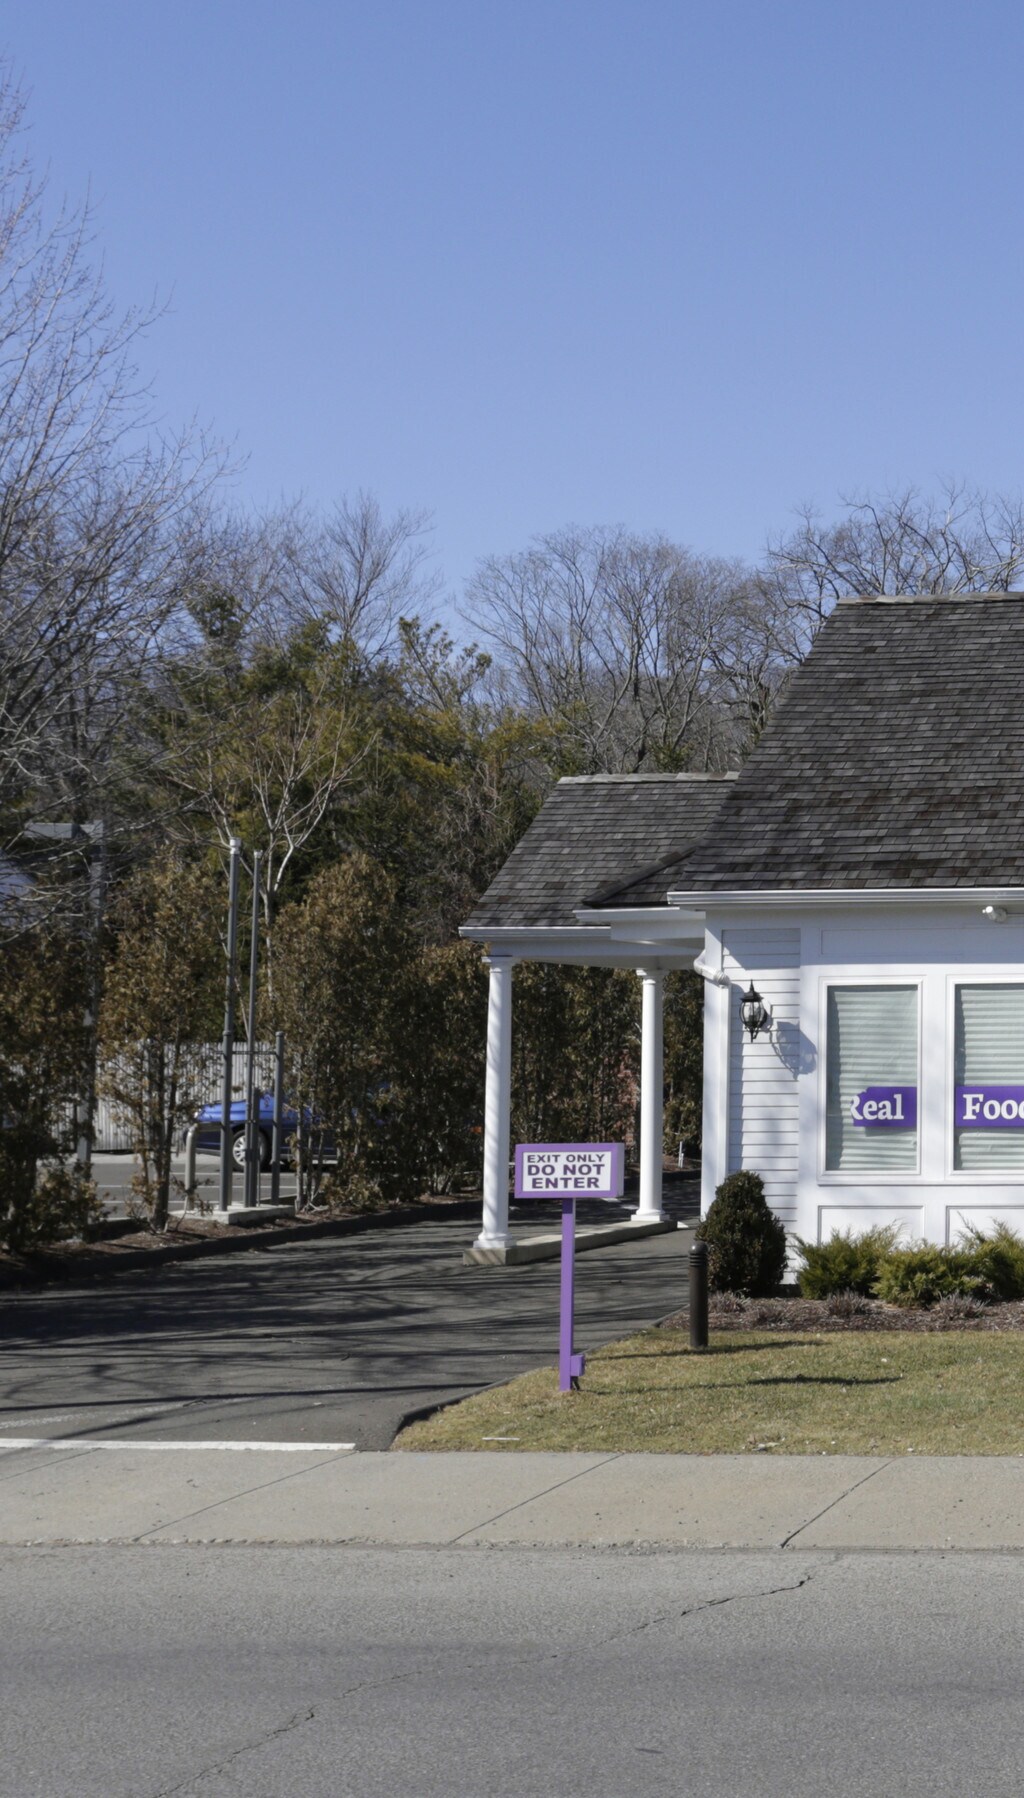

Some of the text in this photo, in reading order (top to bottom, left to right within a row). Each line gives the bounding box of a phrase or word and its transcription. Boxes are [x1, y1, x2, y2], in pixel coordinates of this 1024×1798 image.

[527, 1154, 605, 1163] EXIT ONLY
[528, 1164, 605, 1176] DO NOT
[532, 1177, 600, 1189] ENTER
